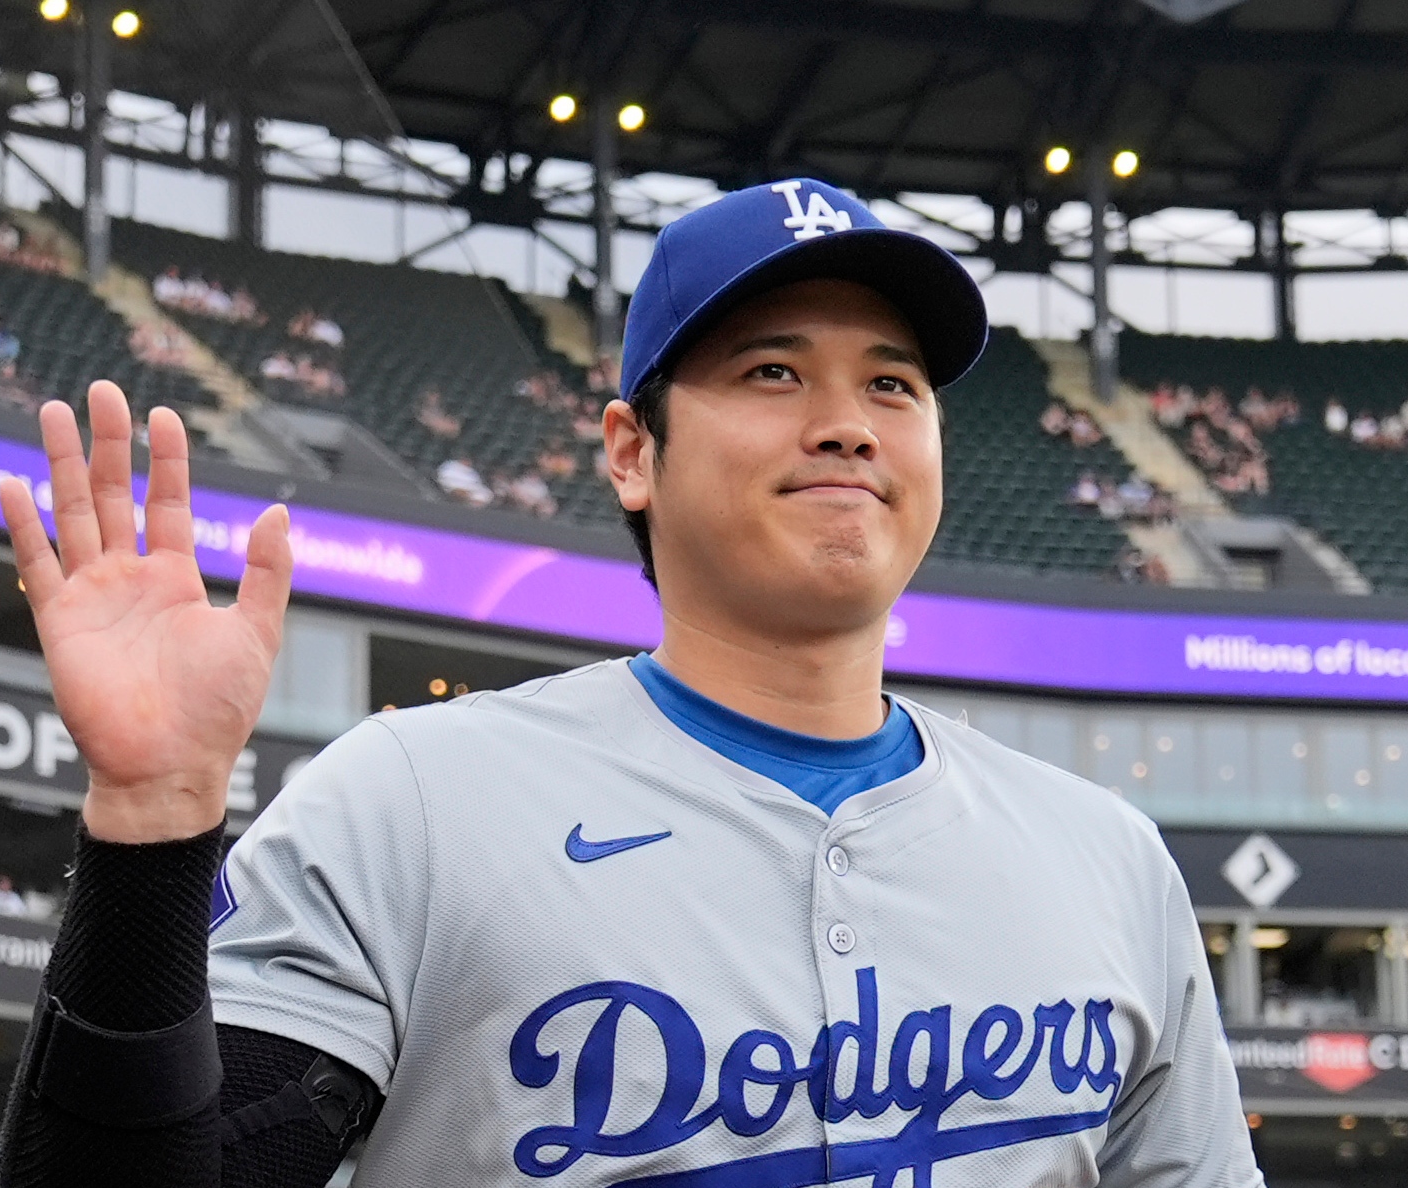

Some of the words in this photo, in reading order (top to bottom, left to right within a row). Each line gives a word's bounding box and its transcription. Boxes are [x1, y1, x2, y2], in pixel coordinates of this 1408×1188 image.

[771, 180, 852, 240] LA
[1184, 634, 1313, 674] Millions
[1314, 638, 1354, 675] of
